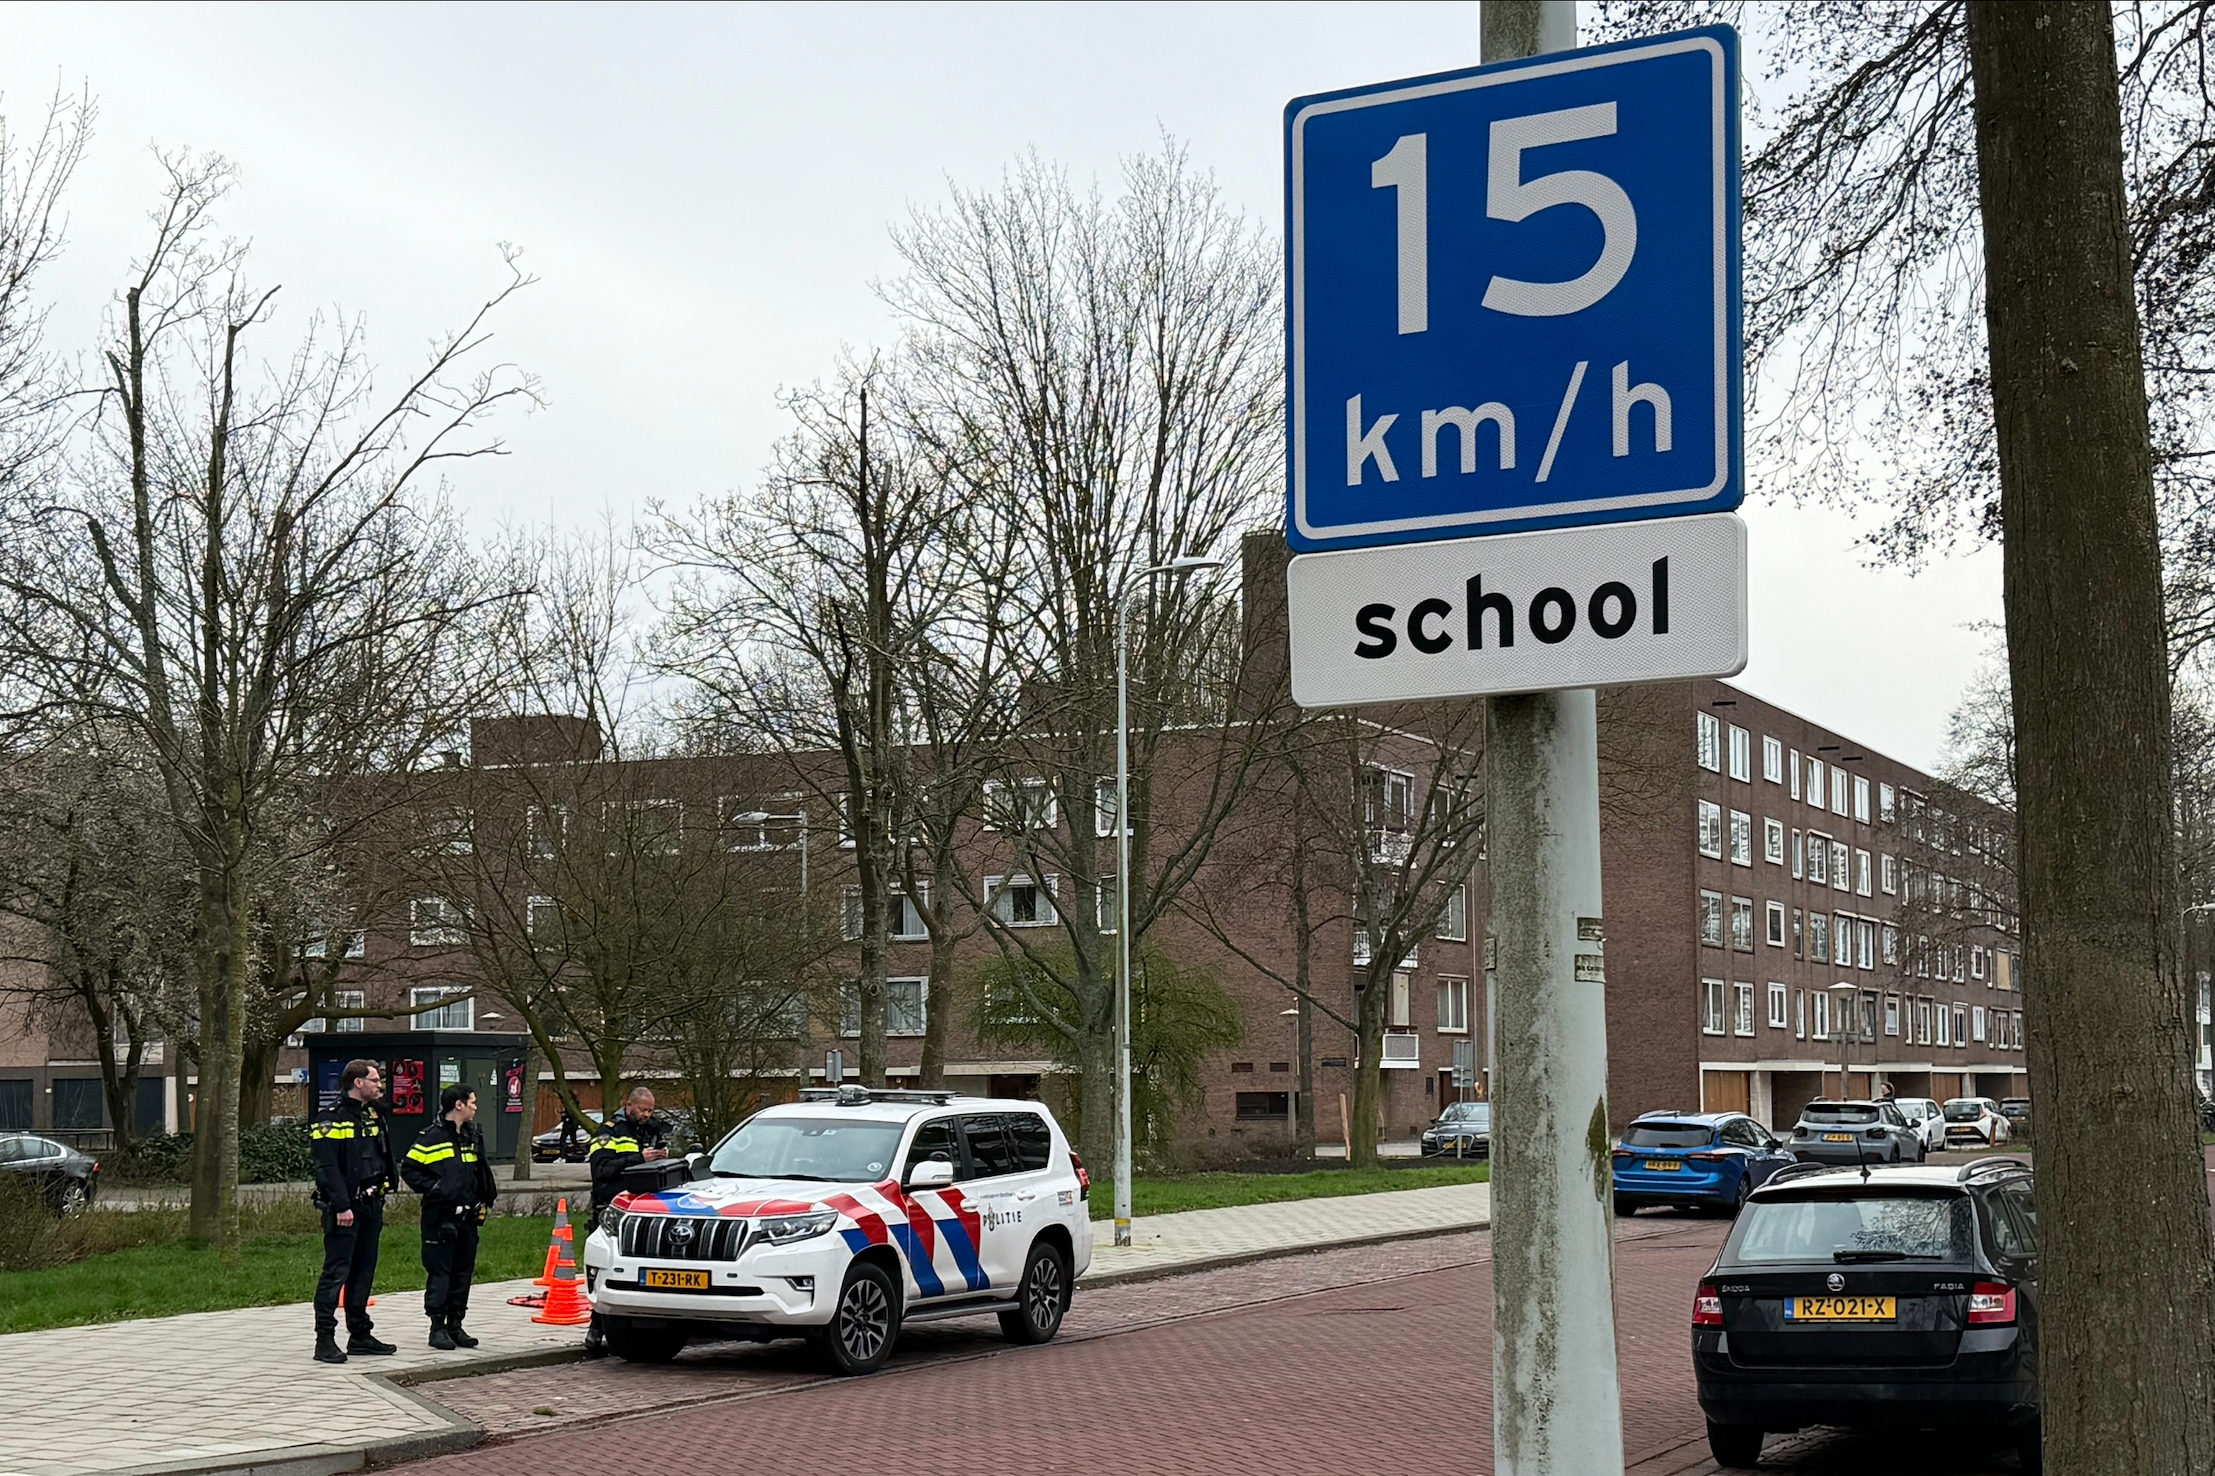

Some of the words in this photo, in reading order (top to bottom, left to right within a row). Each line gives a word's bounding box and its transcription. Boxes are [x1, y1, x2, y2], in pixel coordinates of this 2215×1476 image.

[1372, 102, 1637, 334] 15
[1347, 361, 1672, 486] km/h
[1354, 556, 1668, 660] school
[1803, 1298, 1886, 1316] RZ-021-X
